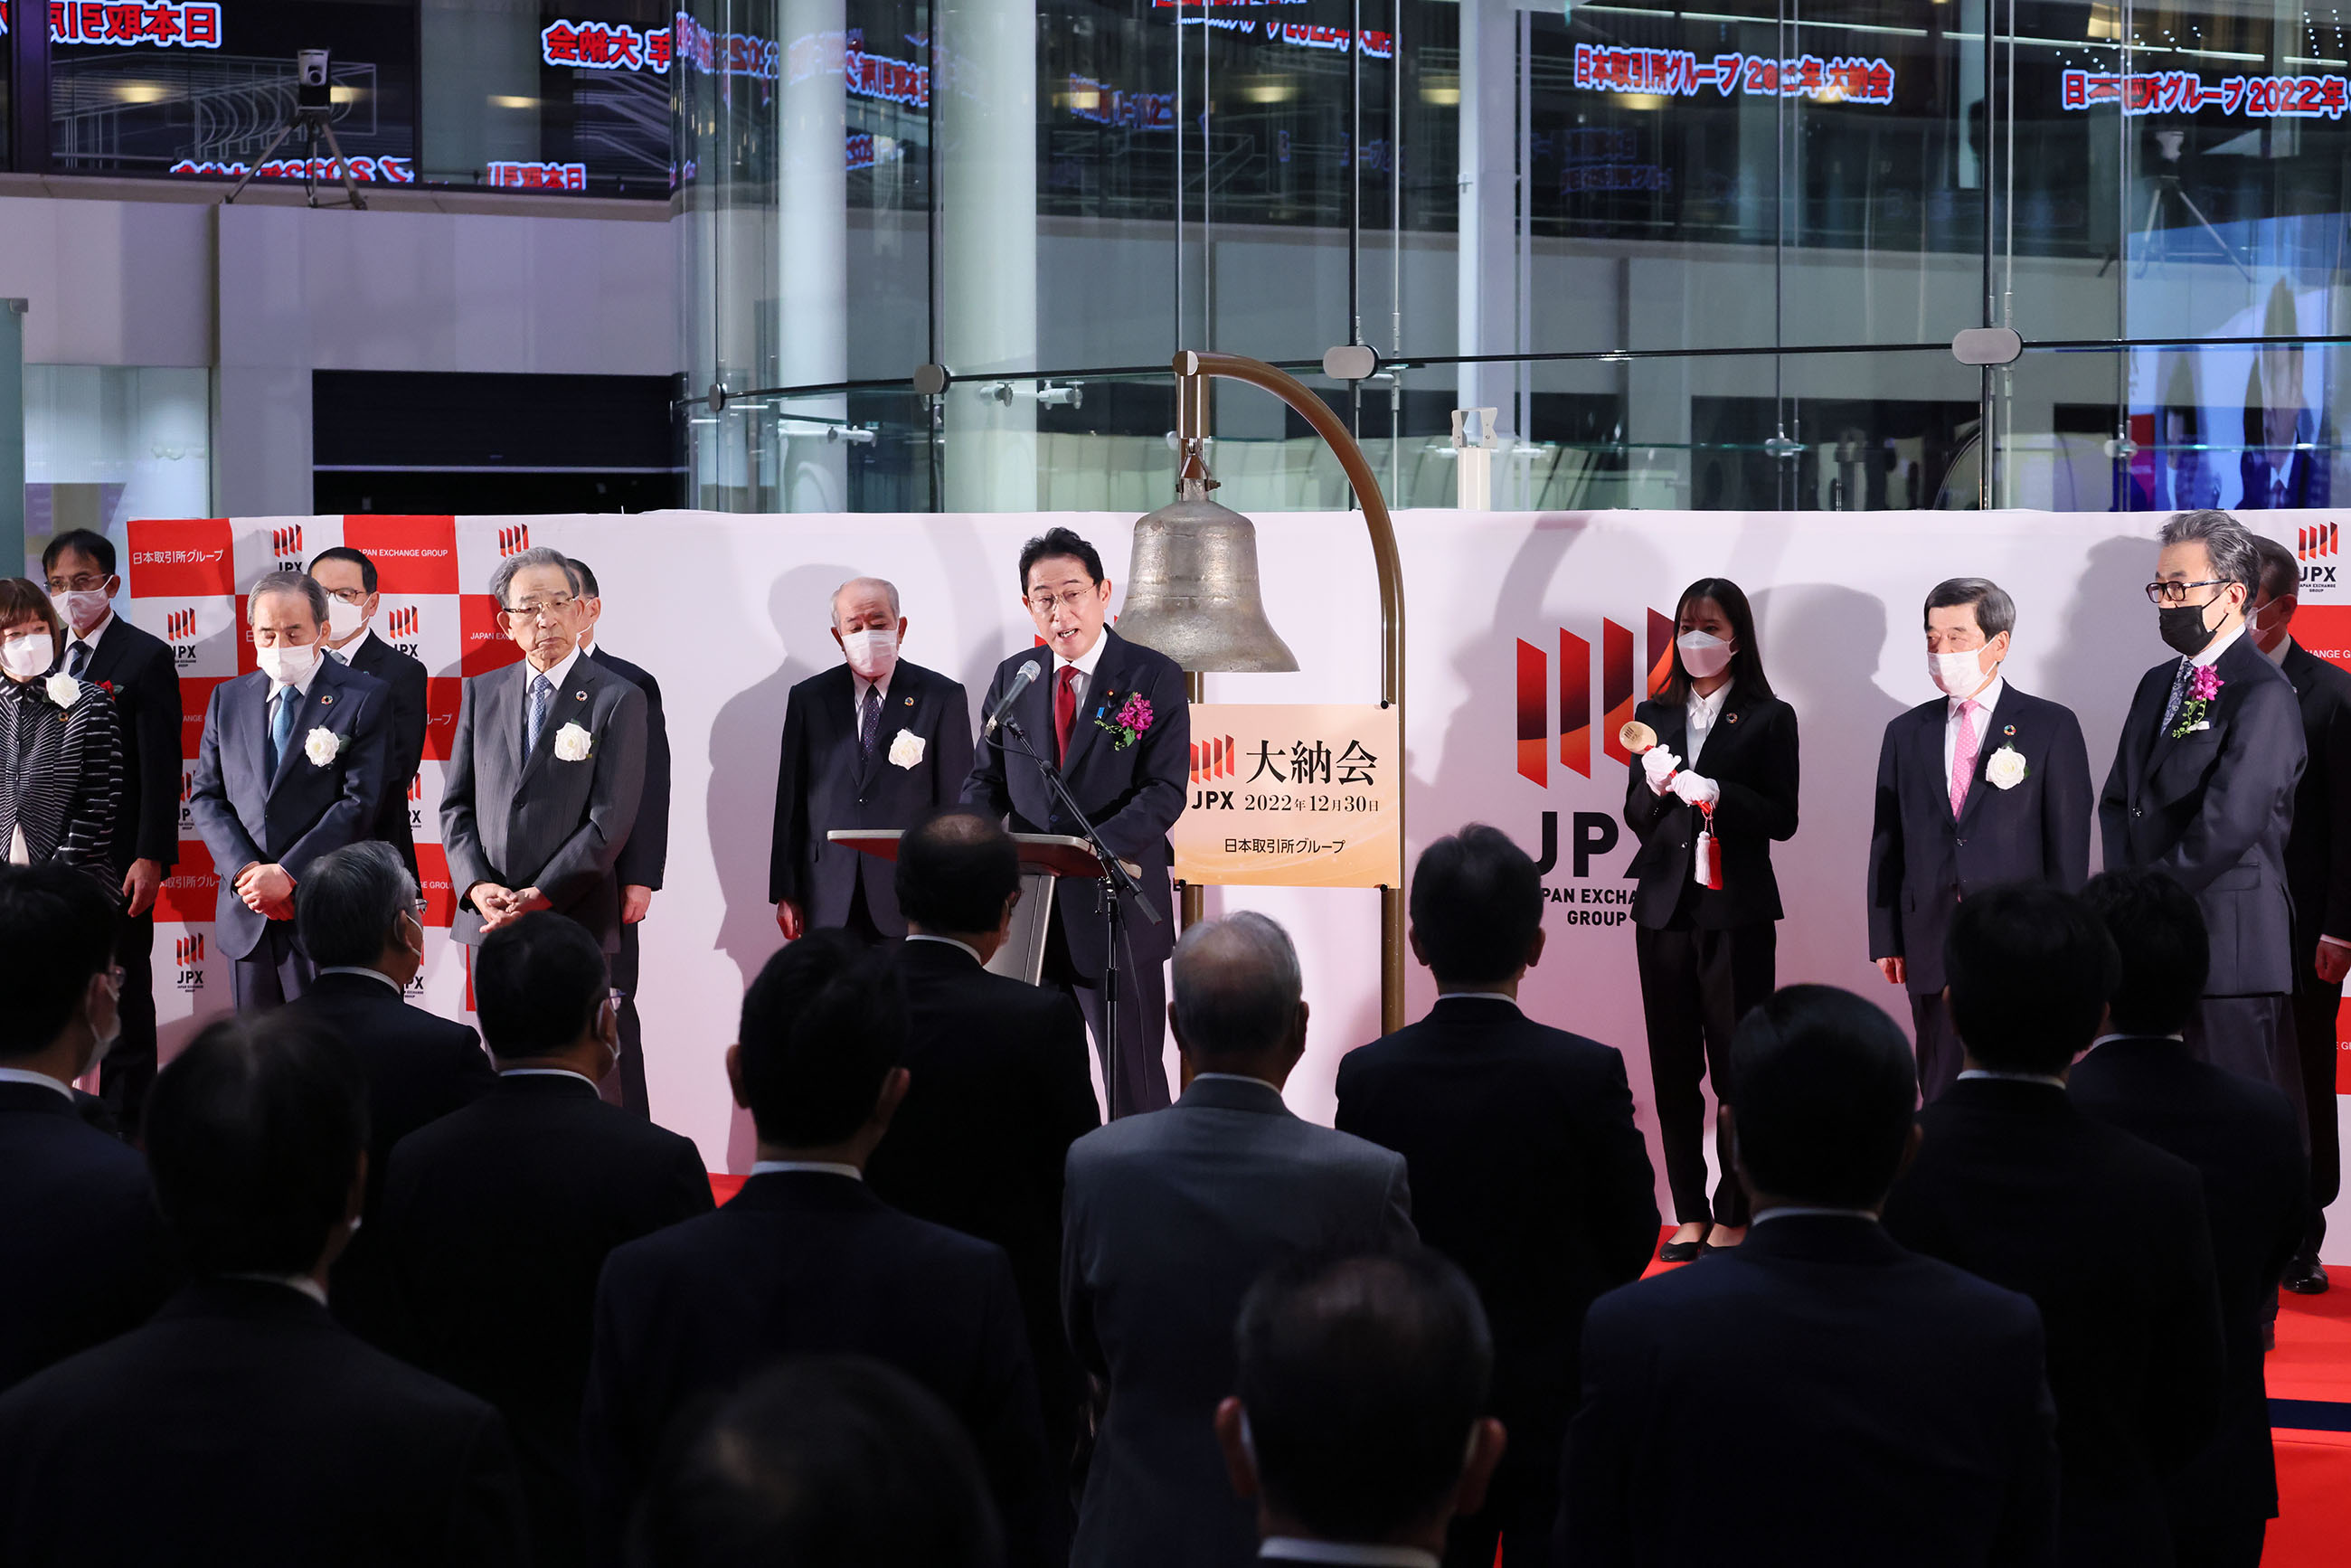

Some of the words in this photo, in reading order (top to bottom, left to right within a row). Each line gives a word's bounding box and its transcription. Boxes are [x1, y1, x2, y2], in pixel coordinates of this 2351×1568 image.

[1575, 45, 1742, 94] 日本取引所グループ
[2248, 76, 2347, 118] 2022年
[133, 550, 224, 564] 日本取引所グループ
[2299, 566, 2337, 581] JPX
[1246, 739, 1378, 785] 大納会
[1192, 791, 1234, 809] JPX
[1245, 794, 1379, 812] 2022年12月30日
[1224, 838, 1345, 854] 日本取引所グループ
[1541, 888, 1574, 902] PAN
[1567, 911, 1627, 926] GROUP
[177, 970, 203, 984] JPX
